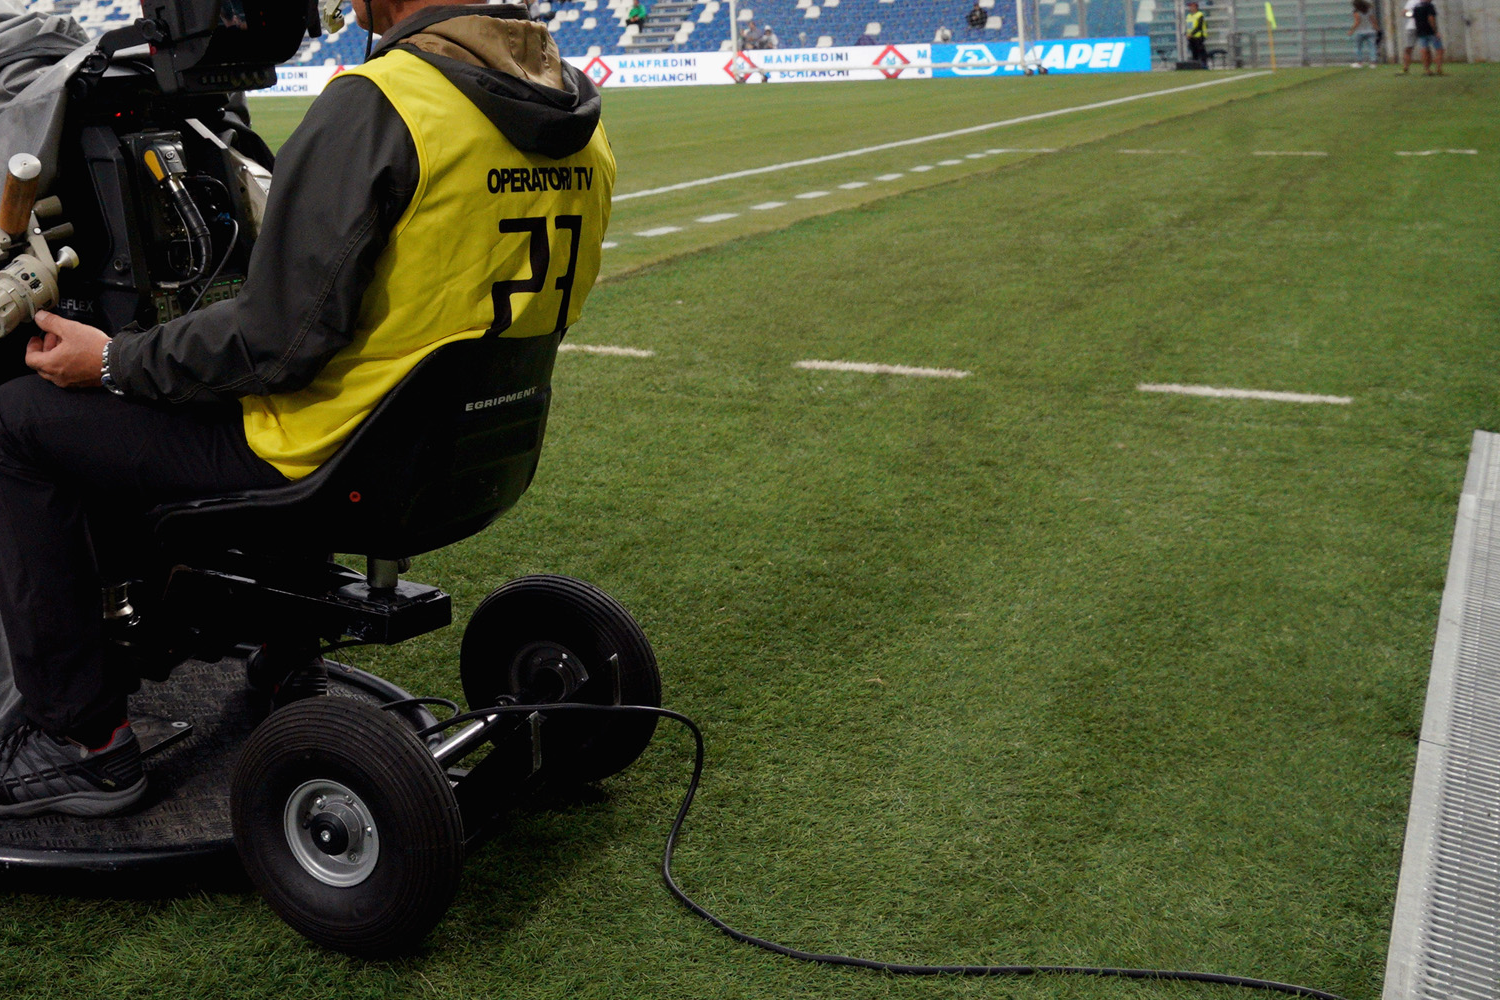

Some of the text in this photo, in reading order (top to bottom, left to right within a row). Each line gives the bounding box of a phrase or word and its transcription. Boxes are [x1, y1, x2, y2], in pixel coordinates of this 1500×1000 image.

[618, 58, 697, 69] MANFREDINI
[764, 52, 849, 64] MANFREDINI
[632, 71, 698, 84] SCHIANCHI
[487, 166, 594, 194] OPERATORI TV
[465, 386, 537, 411] EGRIPMENT
